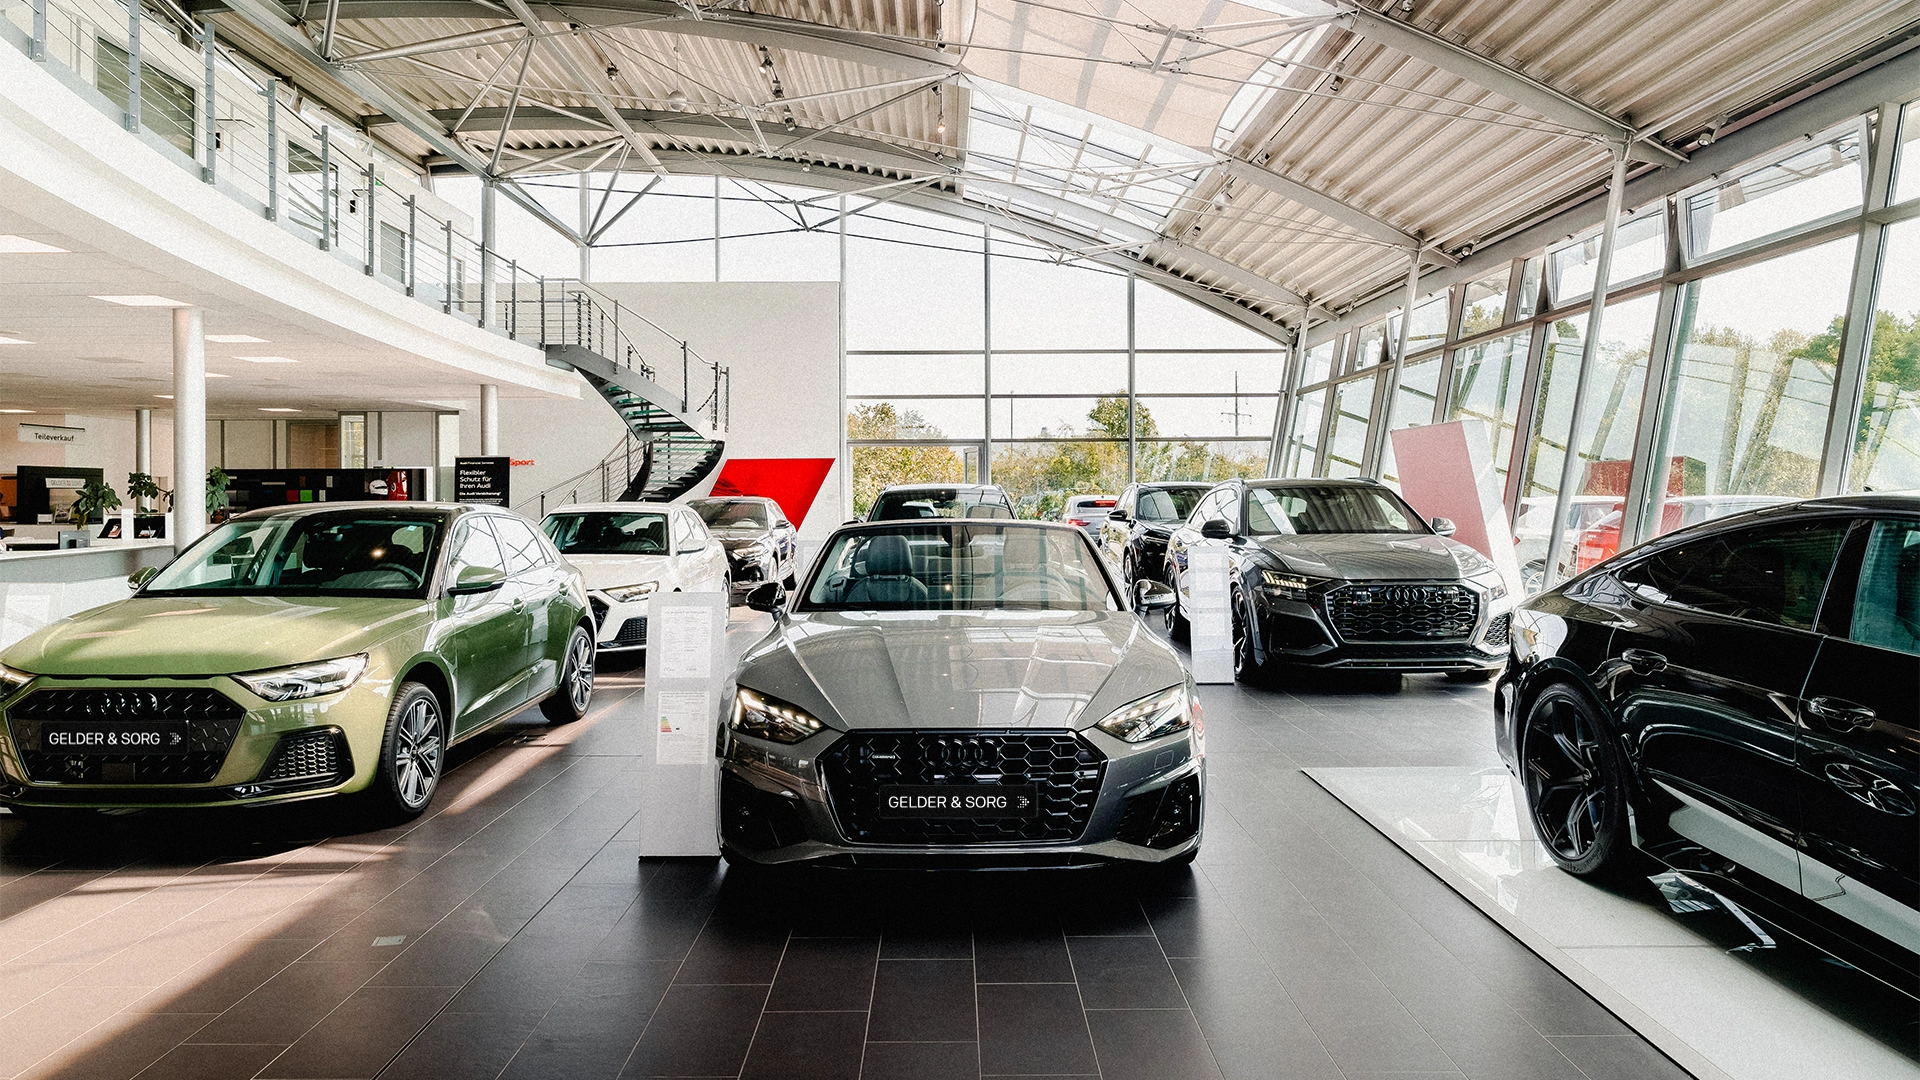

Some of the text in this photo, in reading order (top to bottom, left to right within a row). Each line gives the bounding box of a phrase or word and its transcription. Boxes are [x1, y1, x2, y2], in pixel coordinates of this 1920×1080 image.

[34, 432, 74, 441] Teileverkauf
[510, 458, 534, 466] Sport
[49, 732, 161, 745] GELDER & SORG
[888, 796, 1007, 809] GELDER & SORG
